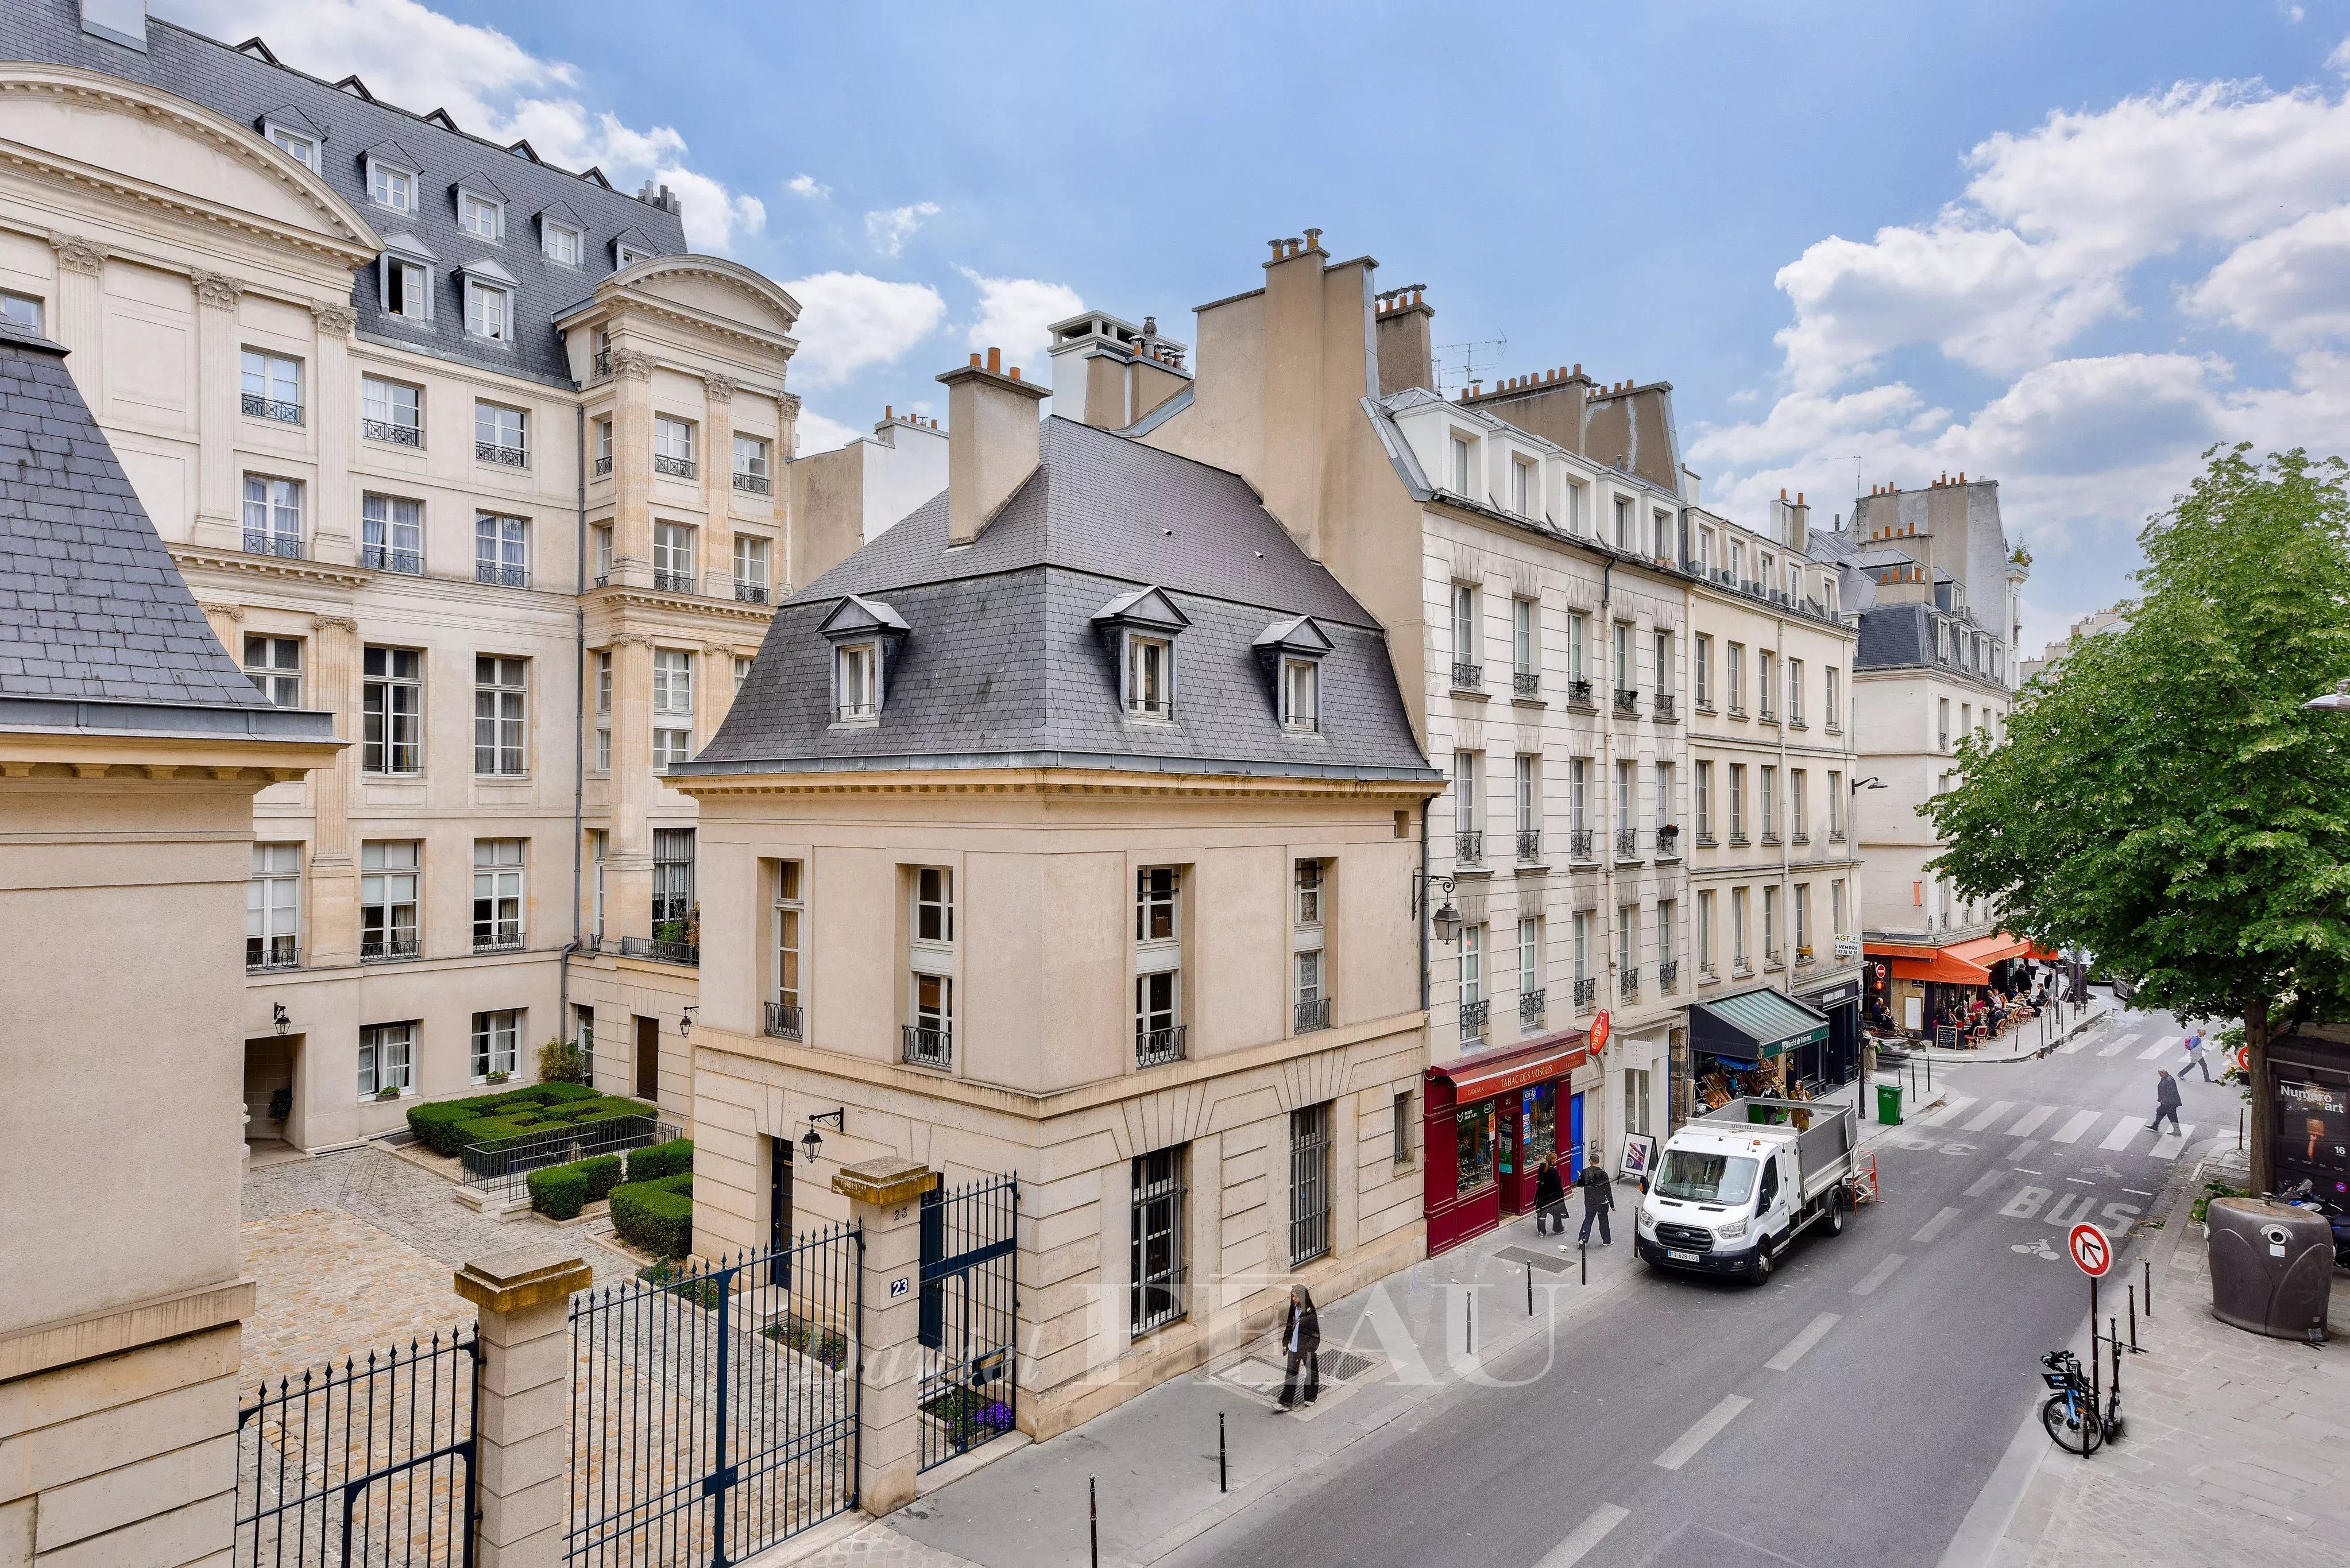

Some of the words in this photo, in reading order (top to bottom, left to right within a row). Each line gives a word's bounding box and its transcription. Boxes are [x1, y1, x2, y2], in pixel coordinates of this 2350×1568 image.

[1591, 1016, 1605, 1050] TABAC
[1500, 1074, 1519, 1088] TABAC
[1520, 1072, 1530, 1083] DES
[1531, 1064, 1553, 1078] VOSGES
[1467, 1086, 1485, 1095] CADEAUX
[2324, 1103, 2344, 1113] art
[2334, 1146, 2345, 1155] 16
[894, 1207, 908, 1221] 23
[1998, 1186, 2142, 1237] BUS
[892, 1279, 909, 1297] 23
